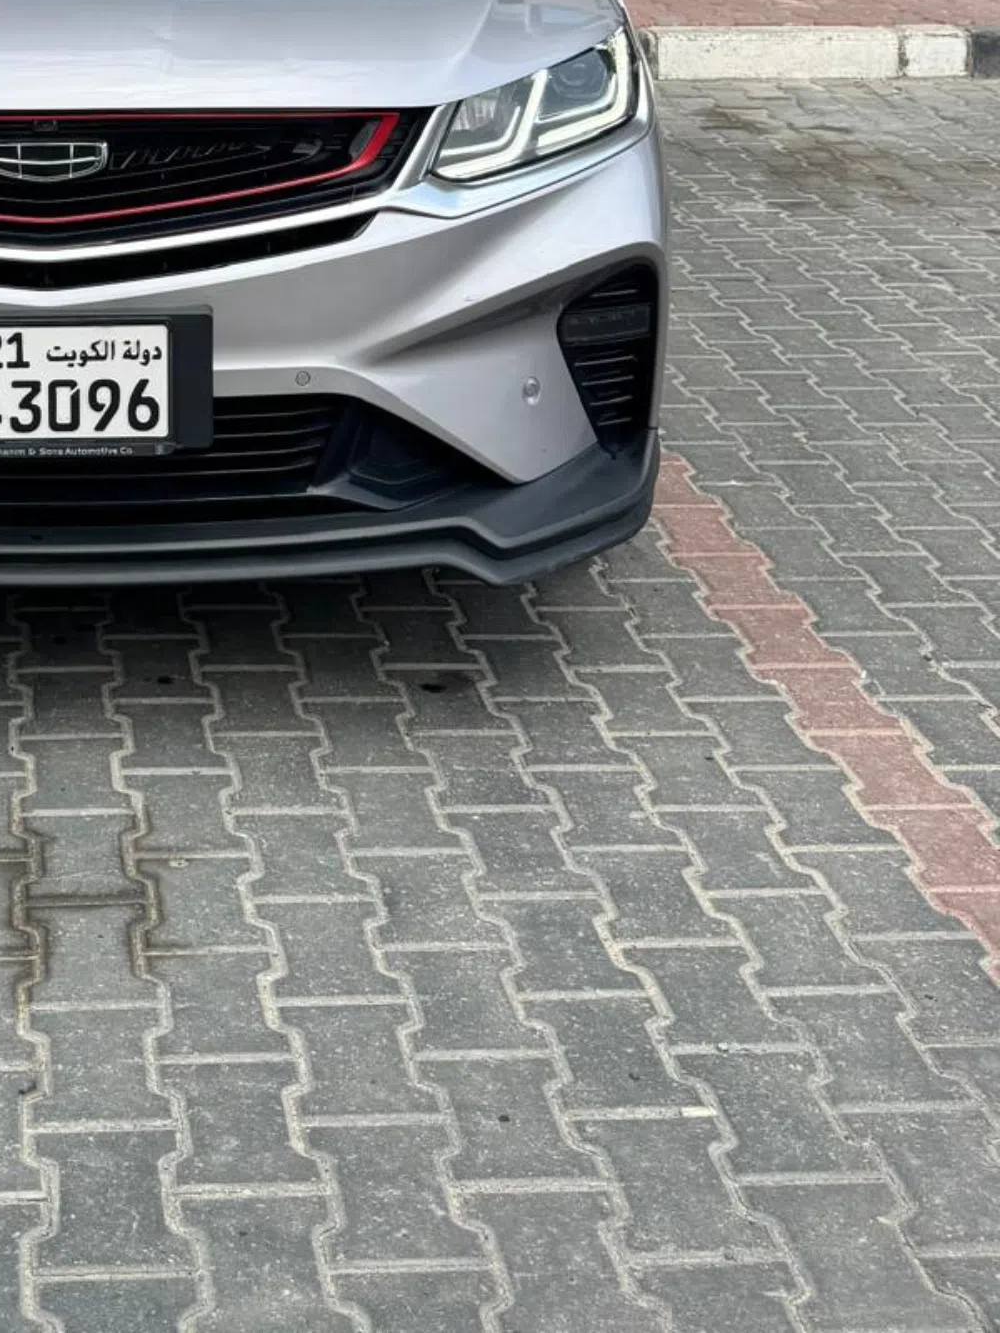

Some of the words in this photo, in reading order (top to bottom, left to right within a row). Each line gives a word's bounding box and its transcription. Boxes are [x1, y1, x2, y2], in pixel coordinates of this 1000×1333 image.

[46, 340, 116, 368] الكويت
[122, 340, 162, 366] دولة
[65, 446, 118, 456] Automotive
